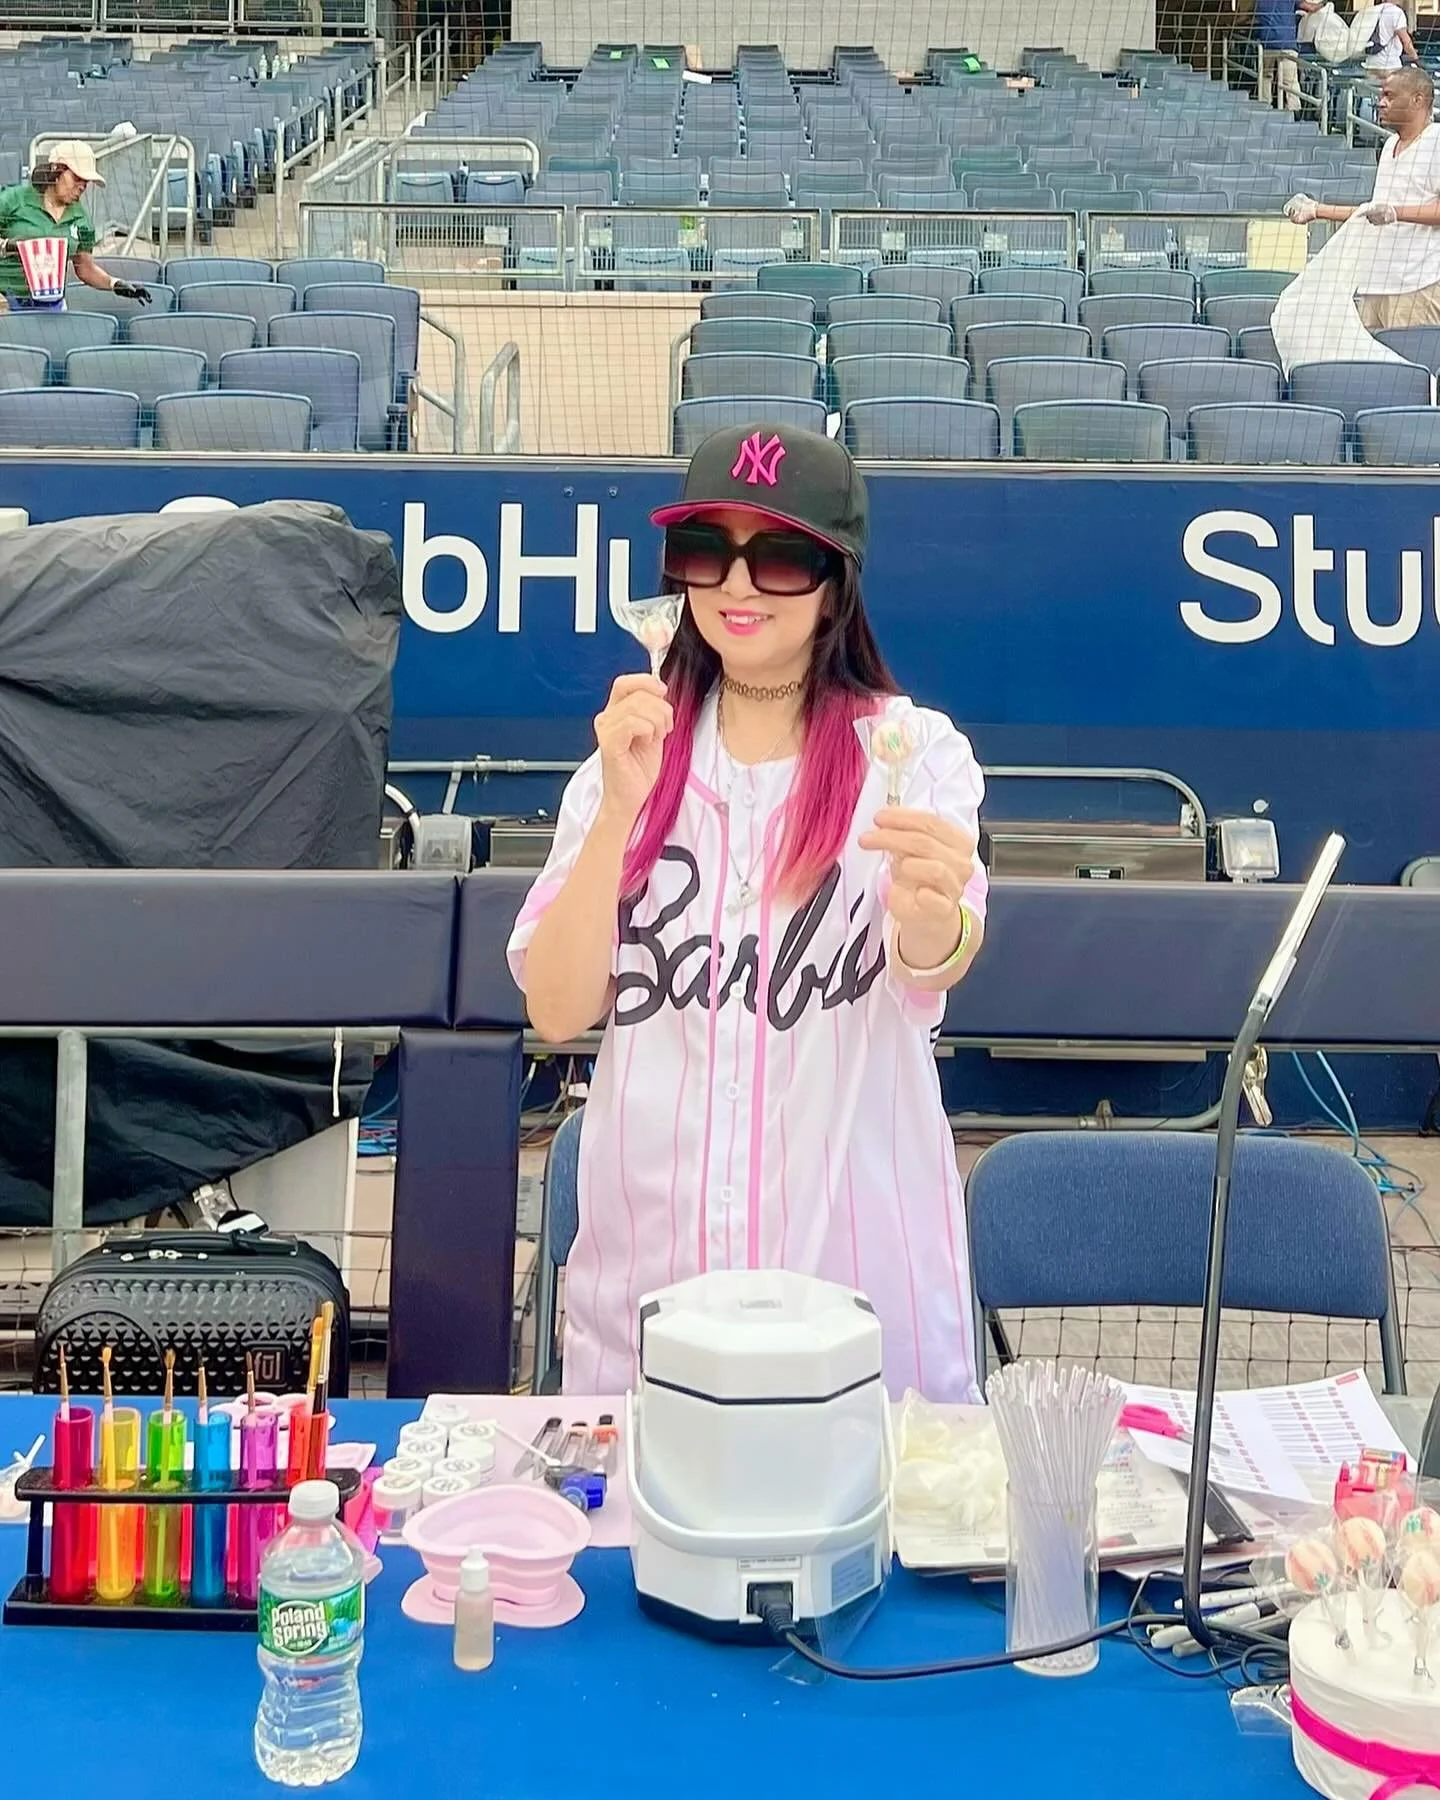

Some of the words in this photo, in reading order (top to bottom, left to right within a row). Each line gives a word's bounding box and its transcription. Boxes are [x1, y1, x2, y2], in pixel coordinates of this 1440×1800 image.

[731, 431, 786, 486] NY
[271, 1600, 326, 1627] Poland
[272, 1619, 328, 1648] Spring
